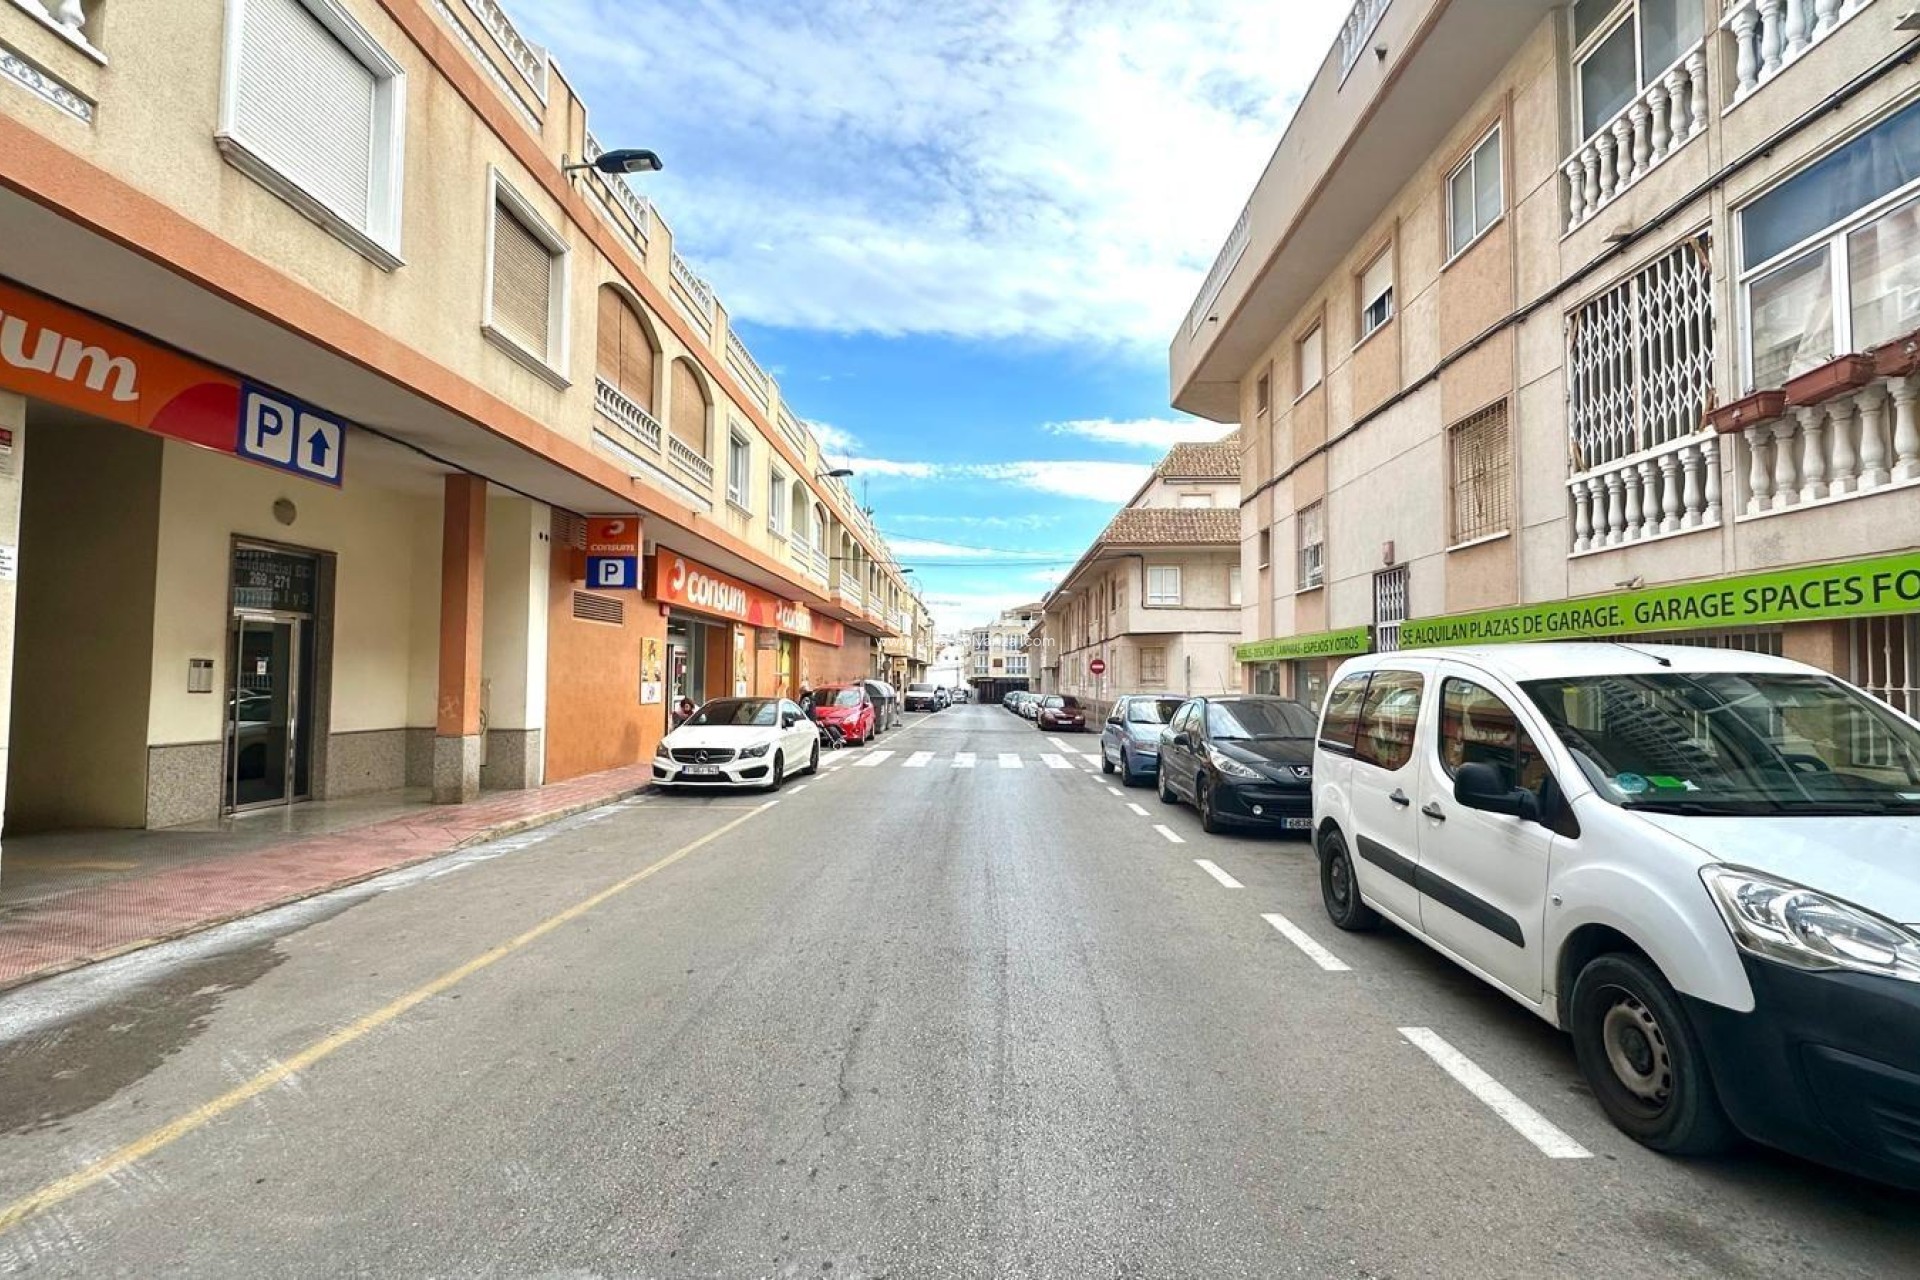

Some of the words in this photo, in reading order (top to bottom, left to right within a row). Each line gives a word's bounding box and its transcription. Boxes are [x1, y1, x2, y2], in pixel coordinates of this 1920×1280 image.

[0, 309, 139, 401] um
[257, 403, 283, 448] P
[590, 544, 634, 552] consum
[605, 563, 618, 582] P
[688, 571, 747, 617] consum
[1402, 629, 1413, 644] SE
[1415, 624, 1467, 643] ALQUILAN
[1470, 617, 1520, 637] PLAZAS
[1523, 613, 1543, 634] DE
[1546, 605, 1624, 632] GARAGE.
[1635, 592, 1735, 624] GARAGE
[1743, 576, 1864, 613] SPACES
